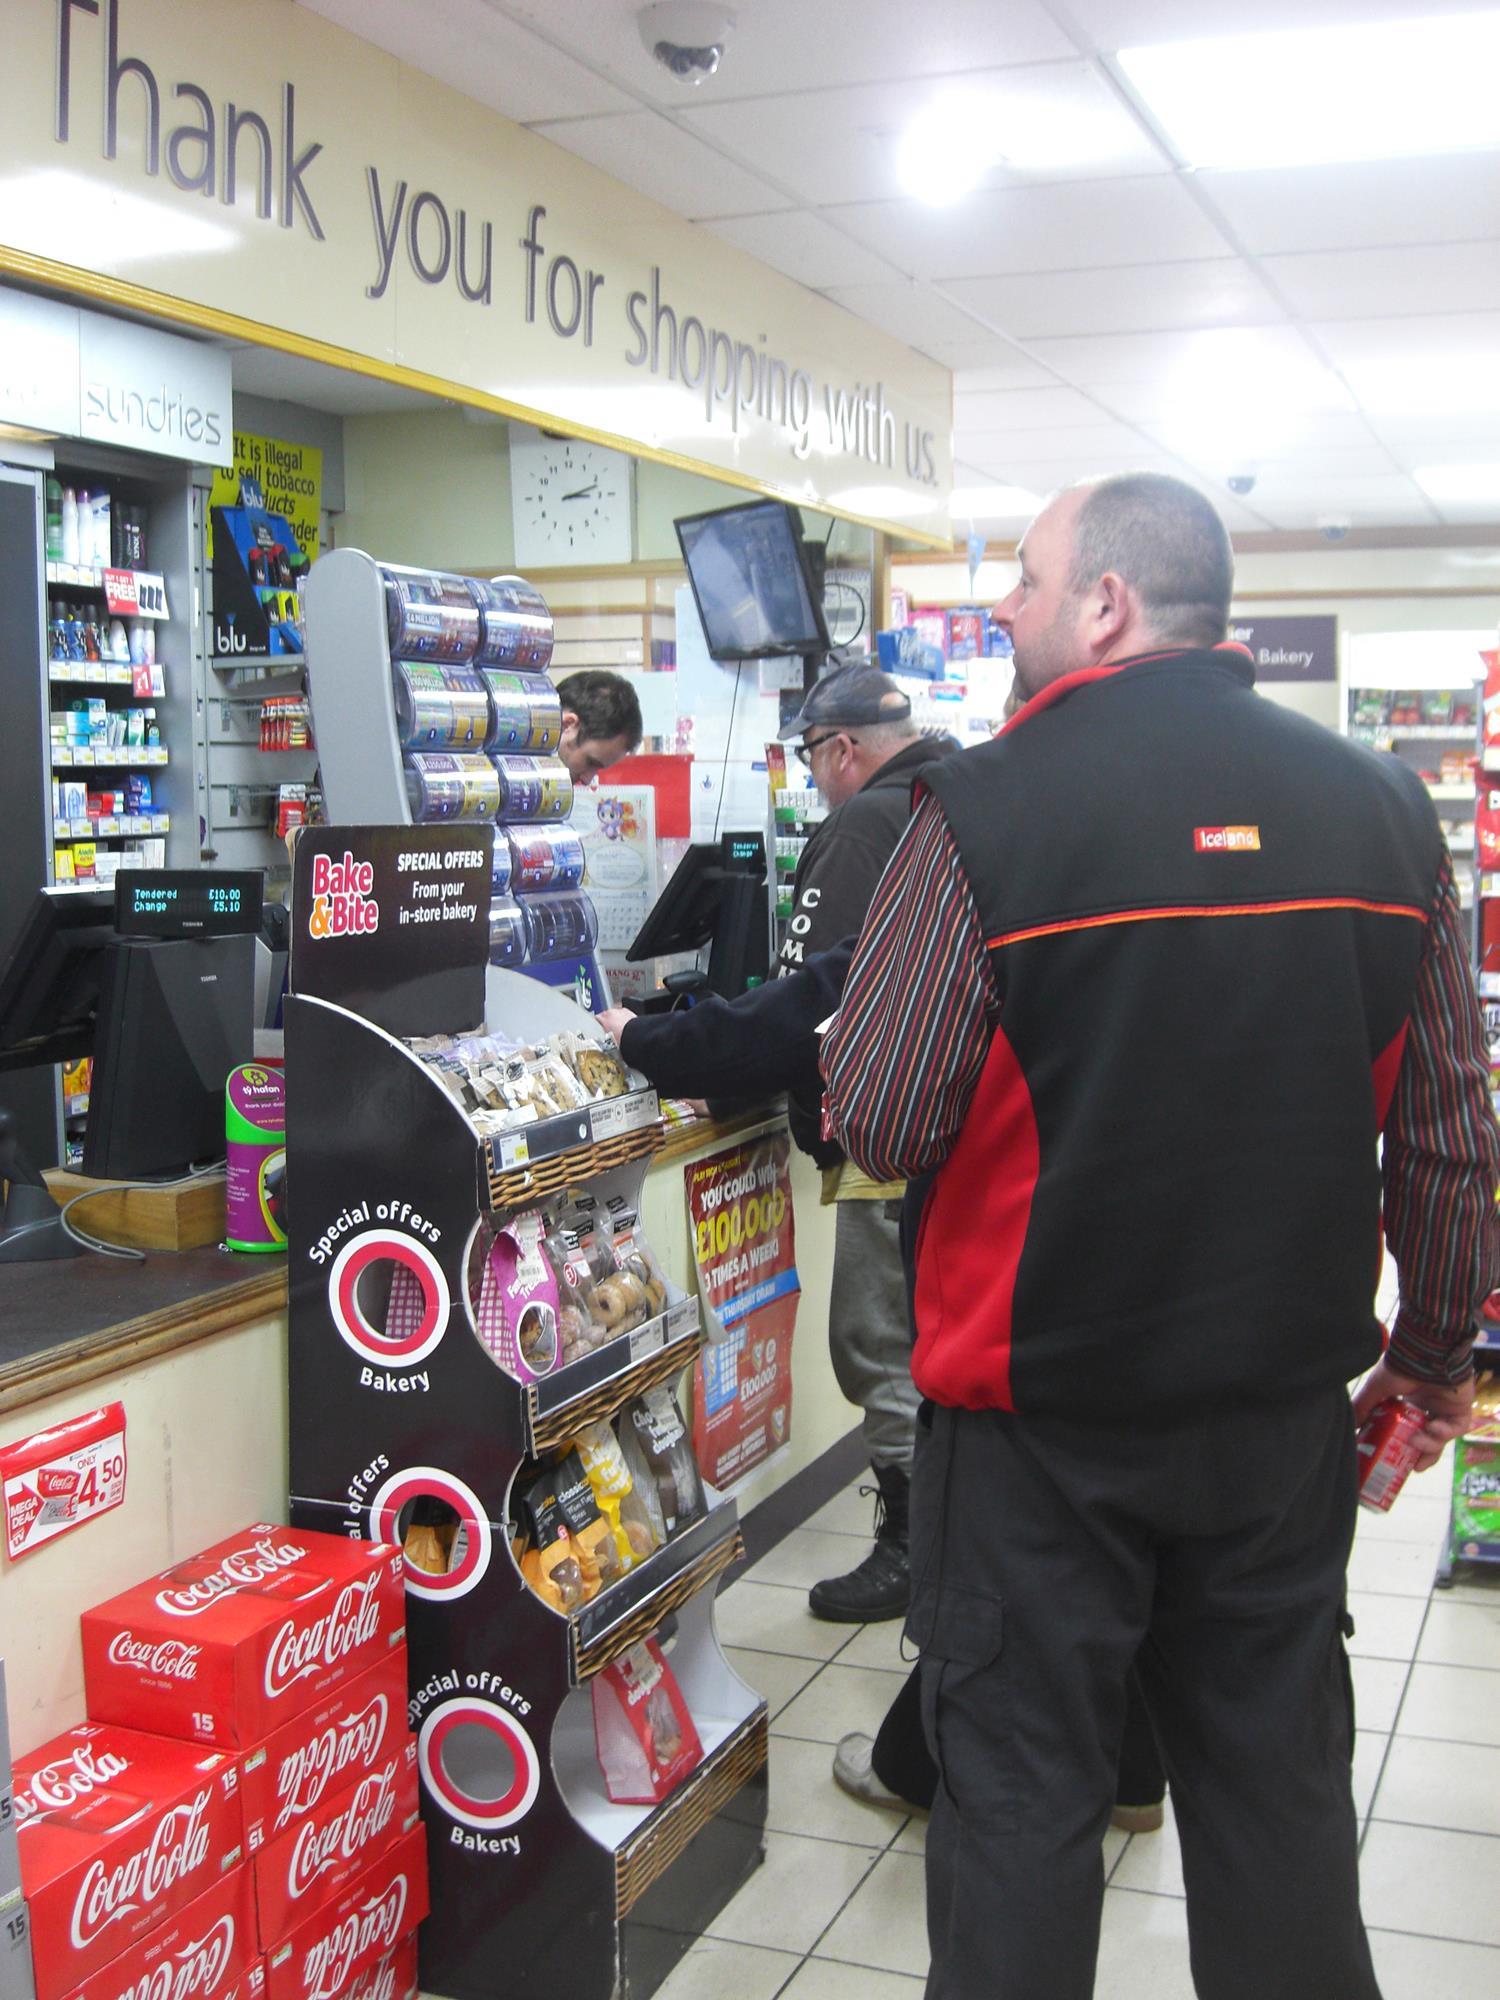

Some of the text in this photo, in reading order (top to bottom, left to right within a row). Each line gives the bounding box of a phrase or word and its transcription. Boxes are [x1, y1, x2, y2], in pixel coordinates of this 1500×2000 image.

[56, 0, 325, 241] Thank
[366, 165, 492, 305] you
[519, 206, 604, 347] for
[626, 266, 814, 460] shopping
[825, 381, 896, 470] with
[87, 382, 221, 446] sundries
[233, 436, 303, 473] It is illegal
[266, 466, 315, 496] tobacco
[242, 483, 264, 509] blu
[263, 489, 296, 515] ducts
[289, 518, 318, 542] nder
[106, 583, 136, 601] FREE
[217, 625, 246, 653] blu
[1259, 647, 1314, 669] Bakery
[1201, 830, 1255, 849] Iceland
[312, 850, 373, 897] Bake
[397, 850, 485, 873] SPECIAL OFFERS
[135, 889, 241, 900] Tendered £10.00
[412, 879, 465, 902] From your
[134, 901, 241, 912] Change £5.10
[399, 902, 477, 925] in-store bakery
[701, 1186, 722, 1212] YOU
[723, 1172, 757, 1203] COULD
[309, 1200, 442, 1264] Special offers
[697, 1187, 785, 1265] £100,000
[704, 1271, 711, 1294] 3
[712, 1256, 740, 1288] TIMES
[740, 1252, 749, 1275] A
[360, 1366, 430, 1392] Bakery
[77, 1454, 97, 1469] ONLY
[348, 1454, 390, 1514] offers
[10, 1496, 39, 1518] MEGA
[11, 1509, 36, 1529] DEAL
[155, 1537, 307, 1616] Coca-Cola
[390, 1555, 403, 1574] 15
[264, 1568, 383, 1698] Coca-Cola
[108, 1631, 203, 1681] Coca-Cola
[466, 1671, 532, 1716] offers
[192, 1712, 215, 1733] 15
[405, 1741, 417, 1762] 15
[14, 1741, 129, 1828] a-Cola
[221, 1766, 238, 1792] 15
[0, 1797, 12, 1822] 5
[288, 1758, 399, 1899] Coca-Cola
[450, 1825, 521, 1855] Bakery
[71, 1784, 214, 1950] Coca-Cola
[8, 1914, 26, 1941] 15
[249, 1964, 265, 1989] 15
